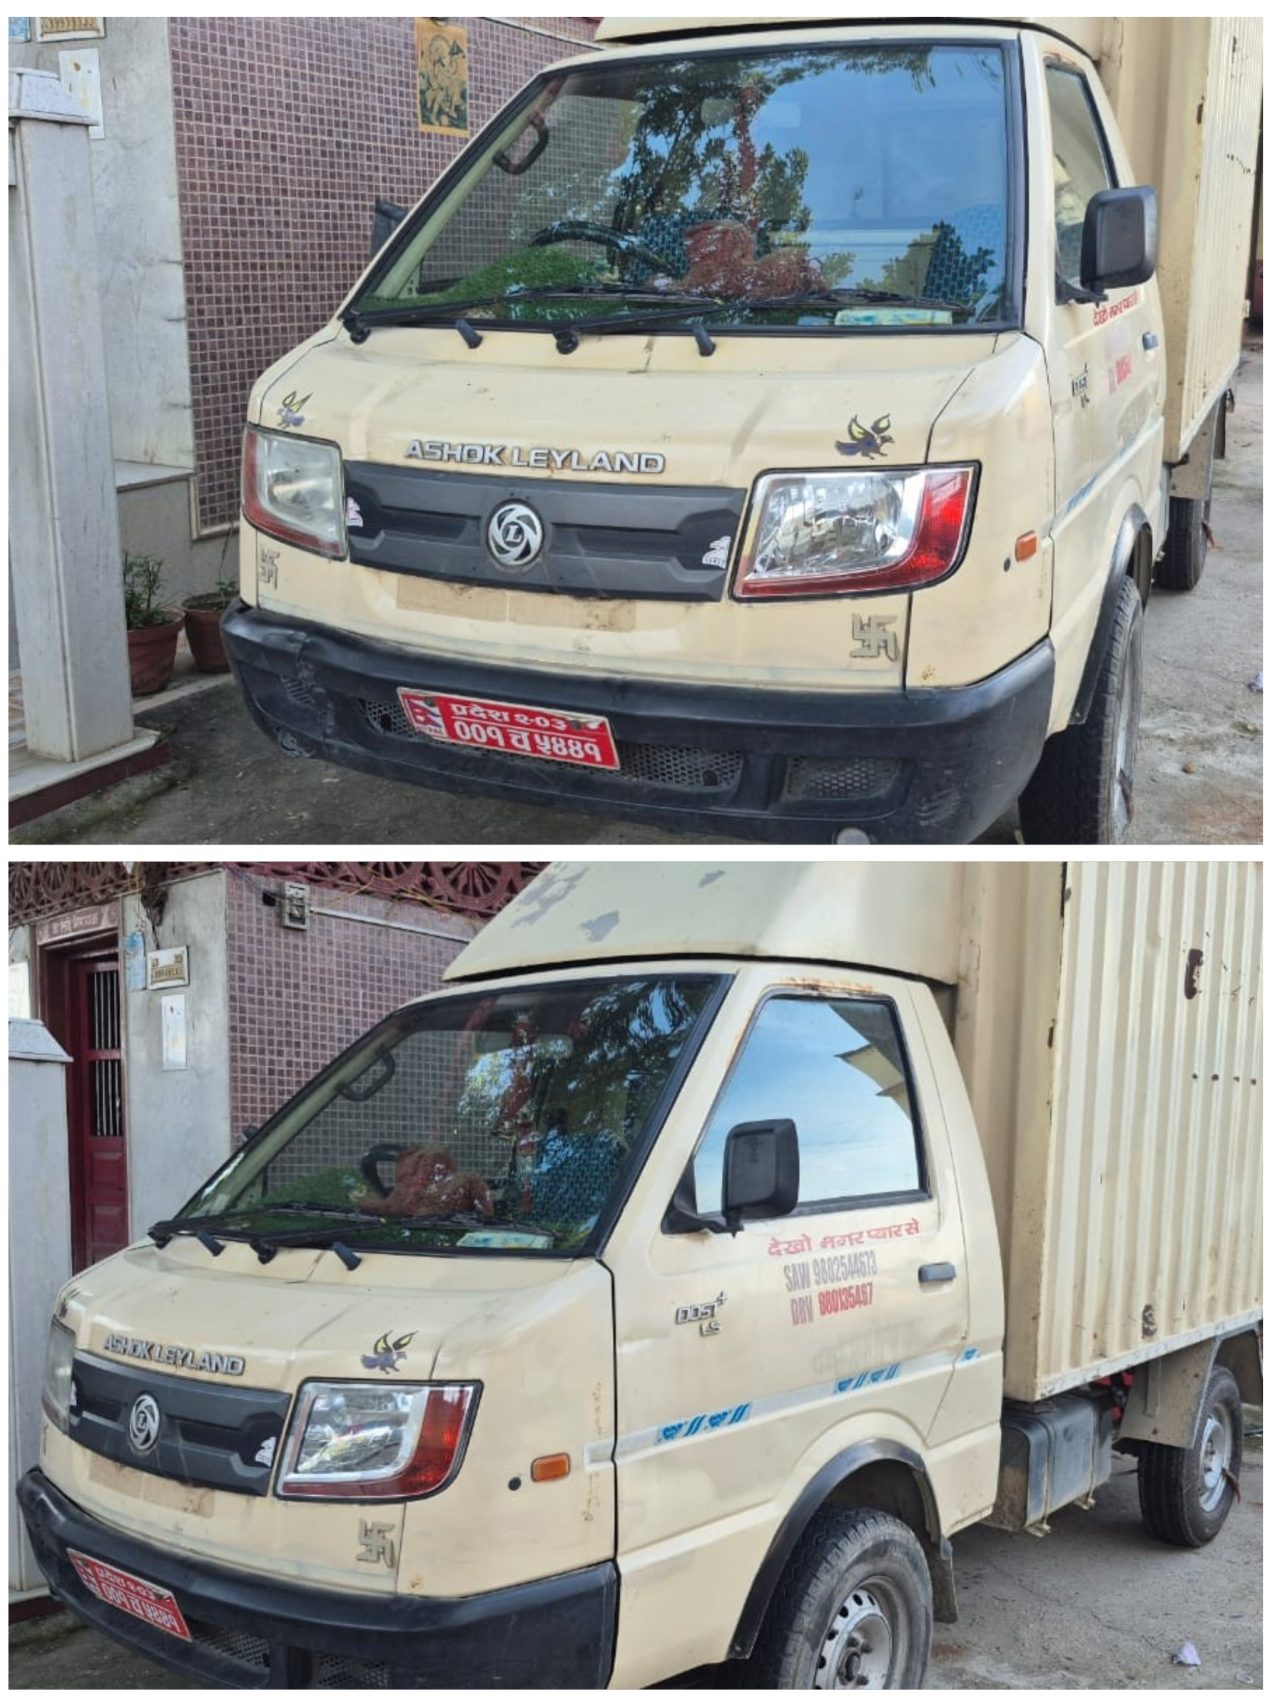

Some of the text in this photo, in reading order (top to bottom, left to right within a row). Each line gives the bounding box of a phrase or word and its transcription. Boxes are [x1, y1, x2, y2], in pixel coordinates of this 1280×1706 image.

[404, 439, 666, 474] ASHOK LEYLAND
[451, 703, 510, 723] प्रदेश
[453, 721, 505, 747] ००१
[534, 733, 603, 763] ५४४१
[104, 1334, 246, 1376] ASHOK LEYLAND
